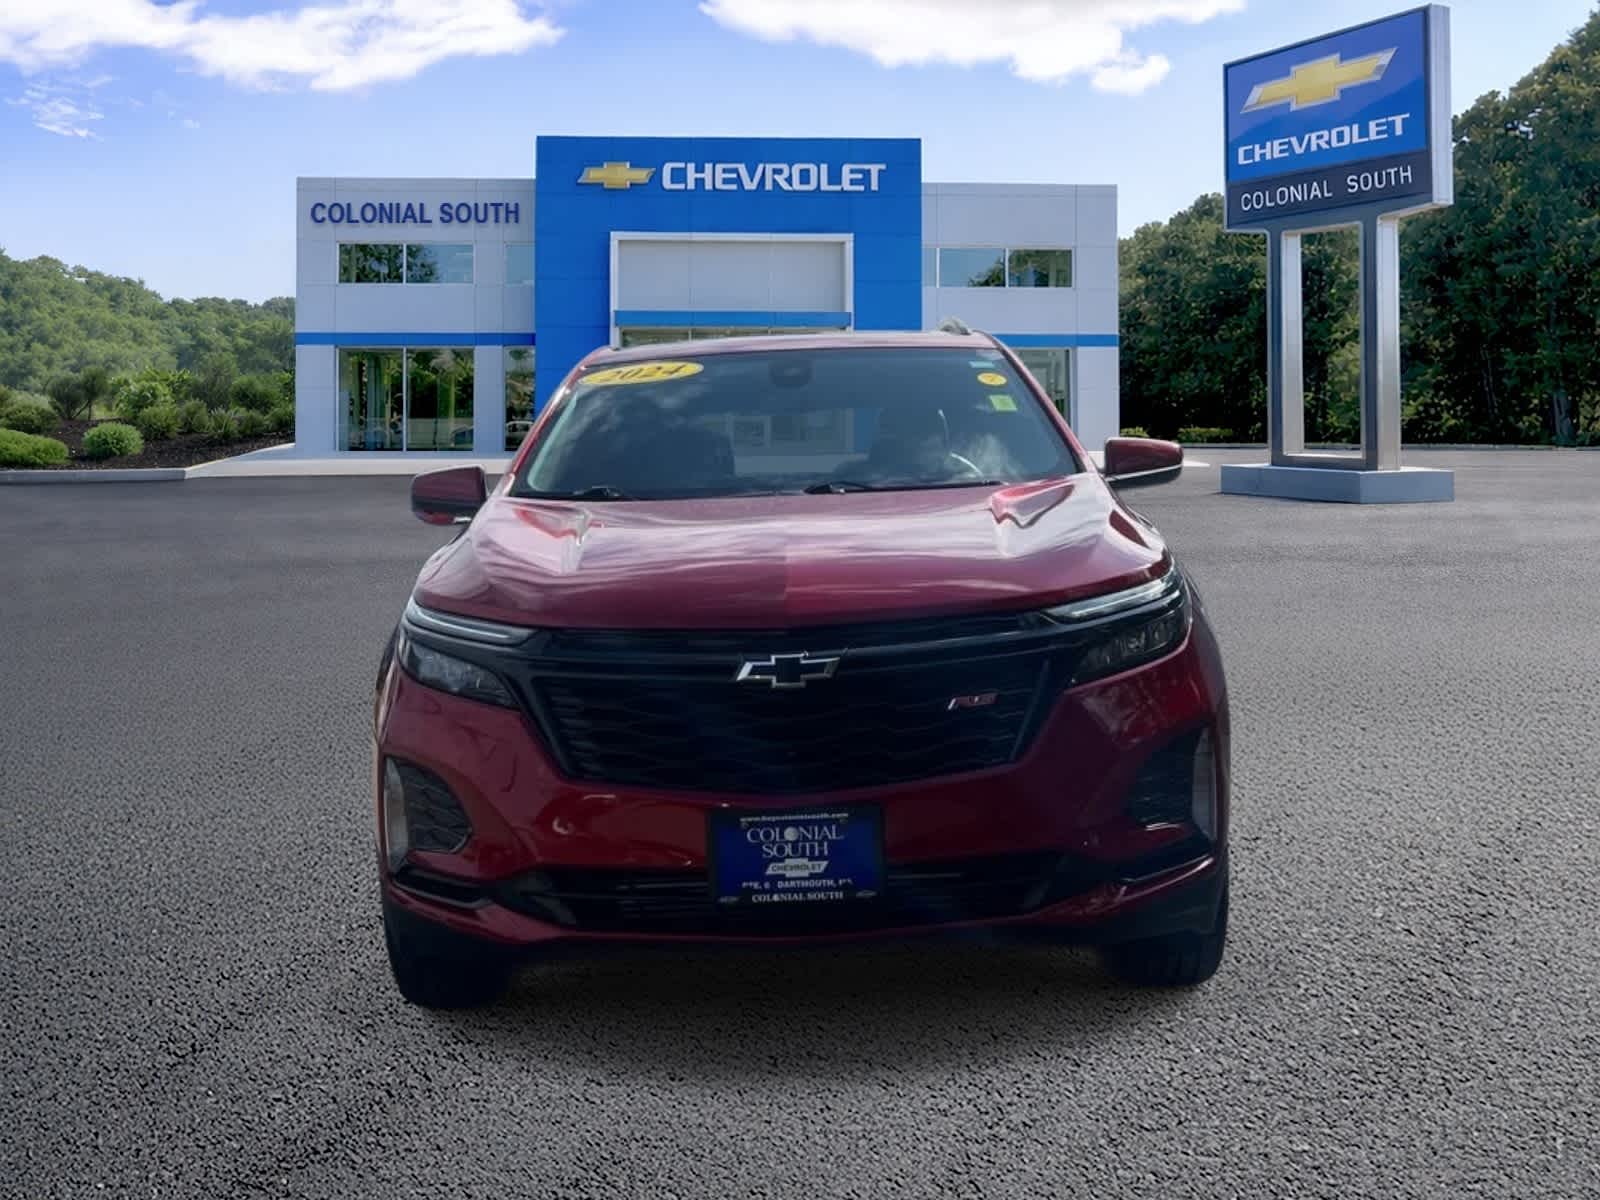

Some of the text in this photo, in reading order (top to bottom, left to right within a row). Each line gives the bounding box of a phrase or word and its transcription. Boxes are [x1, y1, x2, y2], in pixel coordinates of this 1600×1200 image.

[1237, 113, 1410, 165] CHEVROLET
[661, 162, 886, 193] CHEVROLET
[1240, 165, 1413, 212] COLONIAL SOUTH
[310, 202, 520, 224] COLONIAL SOUTH
[746, 824, 844, 843] COLONIAL
[762, 842, 829, 858] SOUTH
[751, 891, 844, 903] COLONIAL SOUTH
